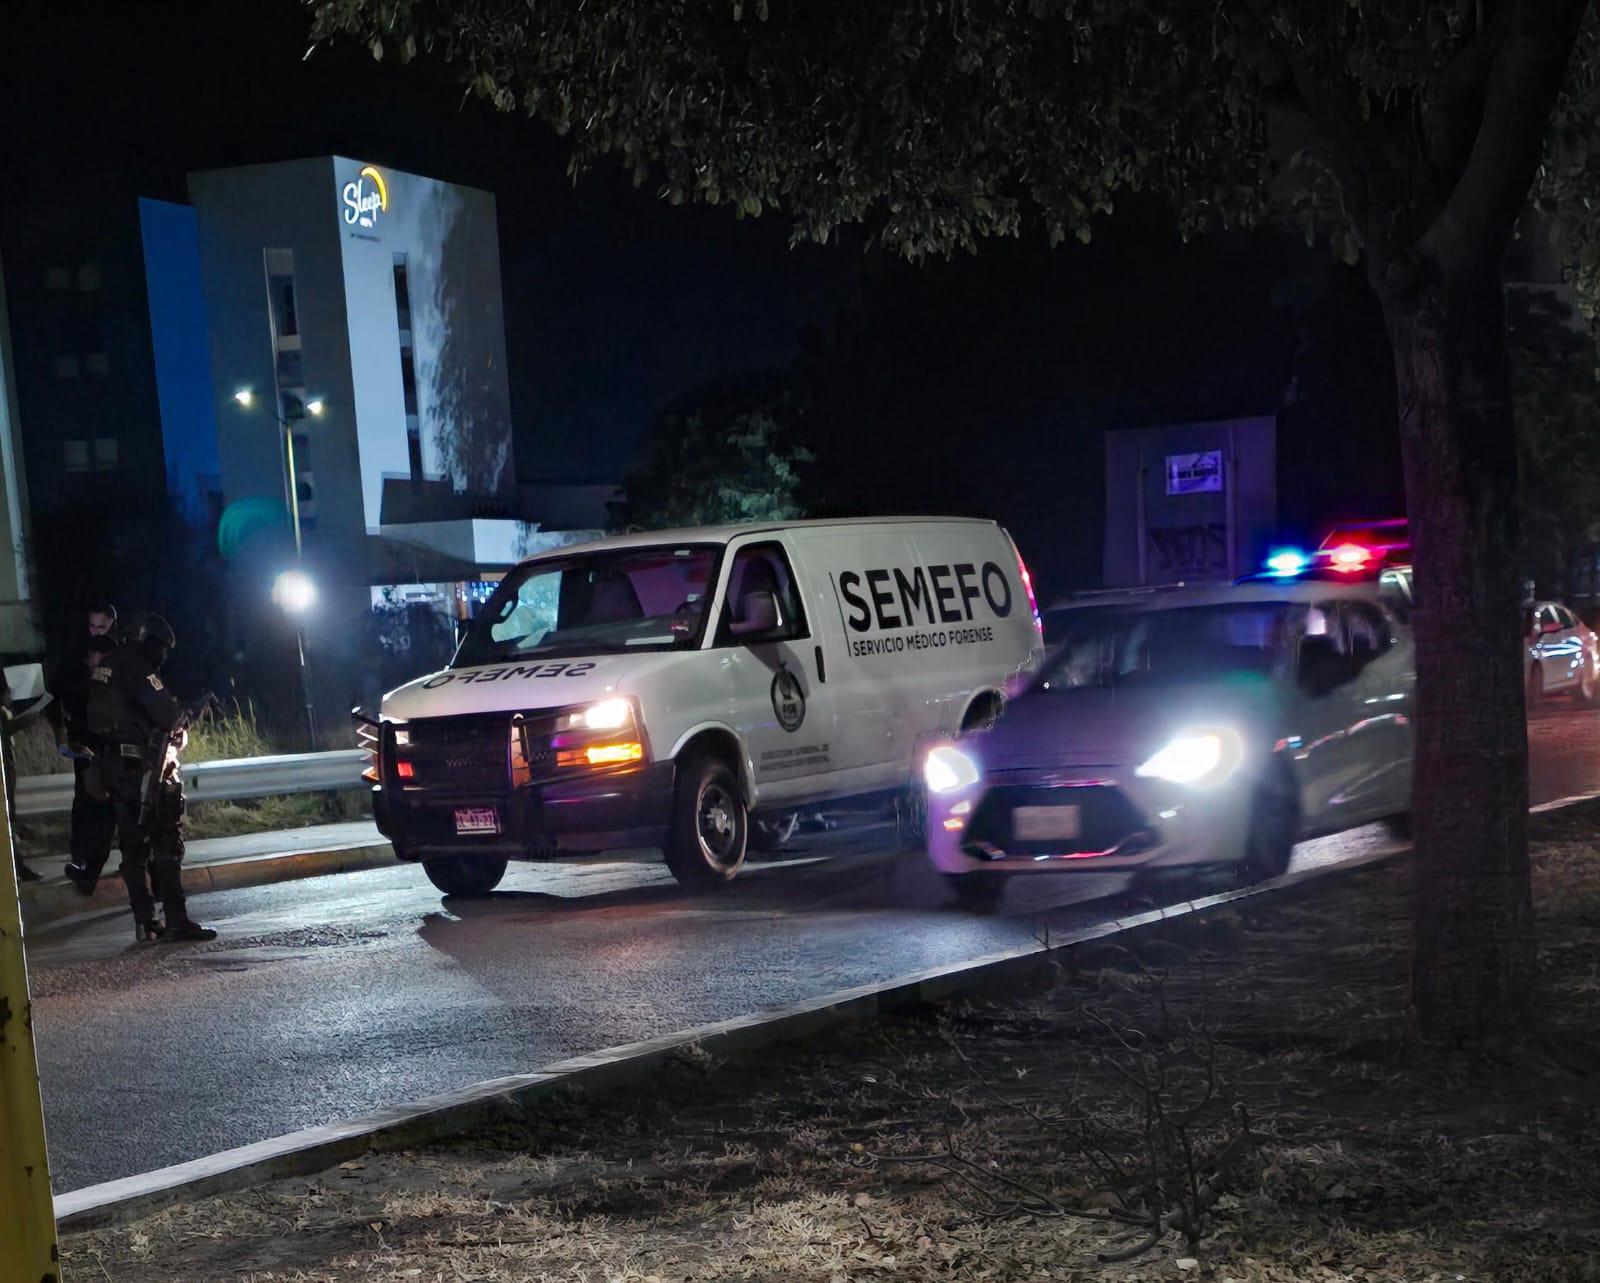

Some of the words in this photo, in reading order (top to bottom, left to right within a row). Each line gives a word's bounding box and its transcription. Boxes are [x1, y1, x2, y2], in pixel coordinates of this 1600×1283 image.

[839, 561, 1012, 632] SEMEFO
[853, 637, 904, 657] SERVICIO
[906, 631, 947, 650] MÉDICO
[949, 627, 994, 645] FORENSE
